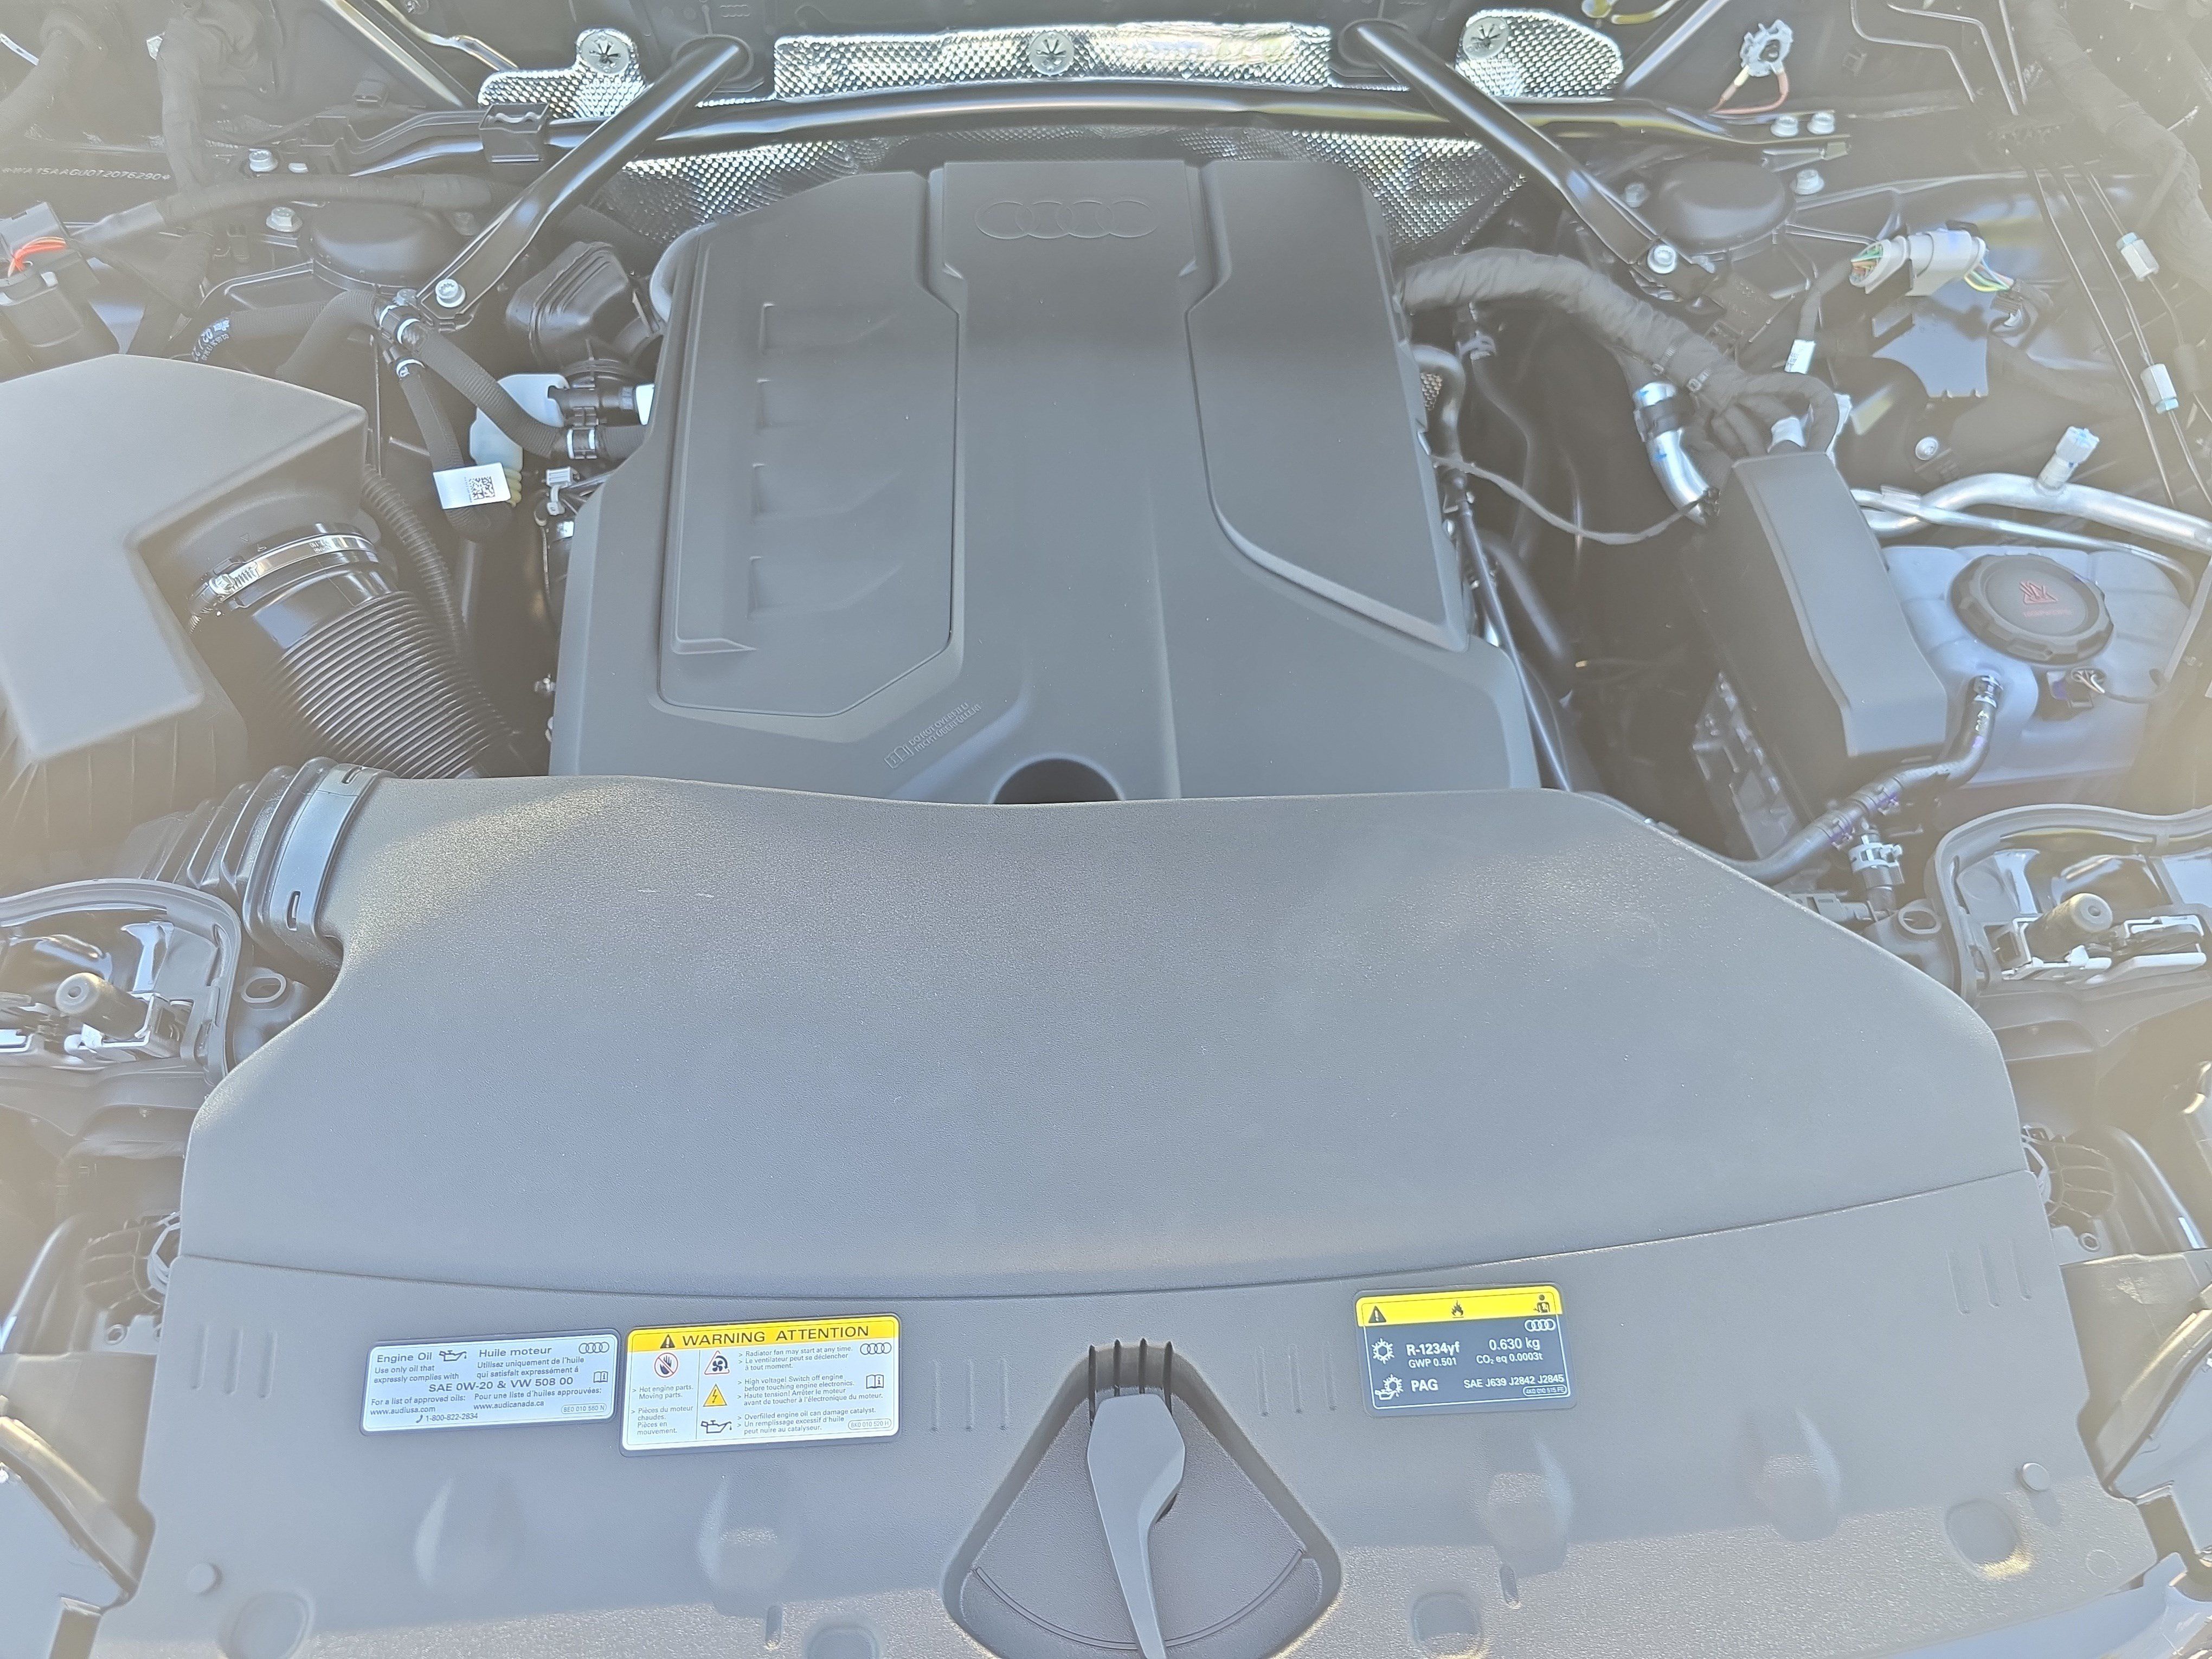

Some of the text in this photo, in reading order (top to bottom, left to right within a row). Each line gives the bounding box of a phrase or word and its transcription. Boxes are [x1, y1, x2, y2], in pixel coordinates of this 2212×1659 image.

[909, 735, 921, 746] DO
[919, 725, 935, 739] NOT
[682, 1325, 869, 1346] WARNING ATTENTION
[1406, 1341, 1460, 1356] R-1234yf
[1489, 1337, 1540, 1351] 0.630 kg
[377, 1352, 432, 1364] Engine Oil
[479, 1348, 552, 1358] Huile moteur
[1495, 1355, 1508, 1364] eq
[1509, 1352, 1543, 1362] 0.0003t
[505, 1359, 549, 1368] uniquement
[1408, 1357, 1457, 1368] GWP 0.501
[390, 1366, 407, 1374] only
[477, 1371, 488, 1379] qui
[490, 1369, 519, 1377] satisfait
[521, 1367, 573, 1377] expressément
[374, 1375, 408, 1384] expressly
[409, 1373, 441, 1382] complies
[745, 1378, 759, 1386] High
[1463, 1374, 1565, 1388] SAE J639 J2842 J2845
[428, 1377, 573, 1392] SAE 0W-20 & VW 508 00
[1411, 1379, 1438, 1392] PAG
[526, 1389, 555, 1397] d'huiles
[557, 1387, 601, 1397] approuvées:
[414, 1394, 448, 1405] approved
[473, 1400, 544, 1410] www.audicanada.ca
[370, 1406, 435, 1415] www.audiusa.com
[426, 1412, 478, 1422] 1-800-822-2834
[755, 1419, 794, 1428] remplissage
